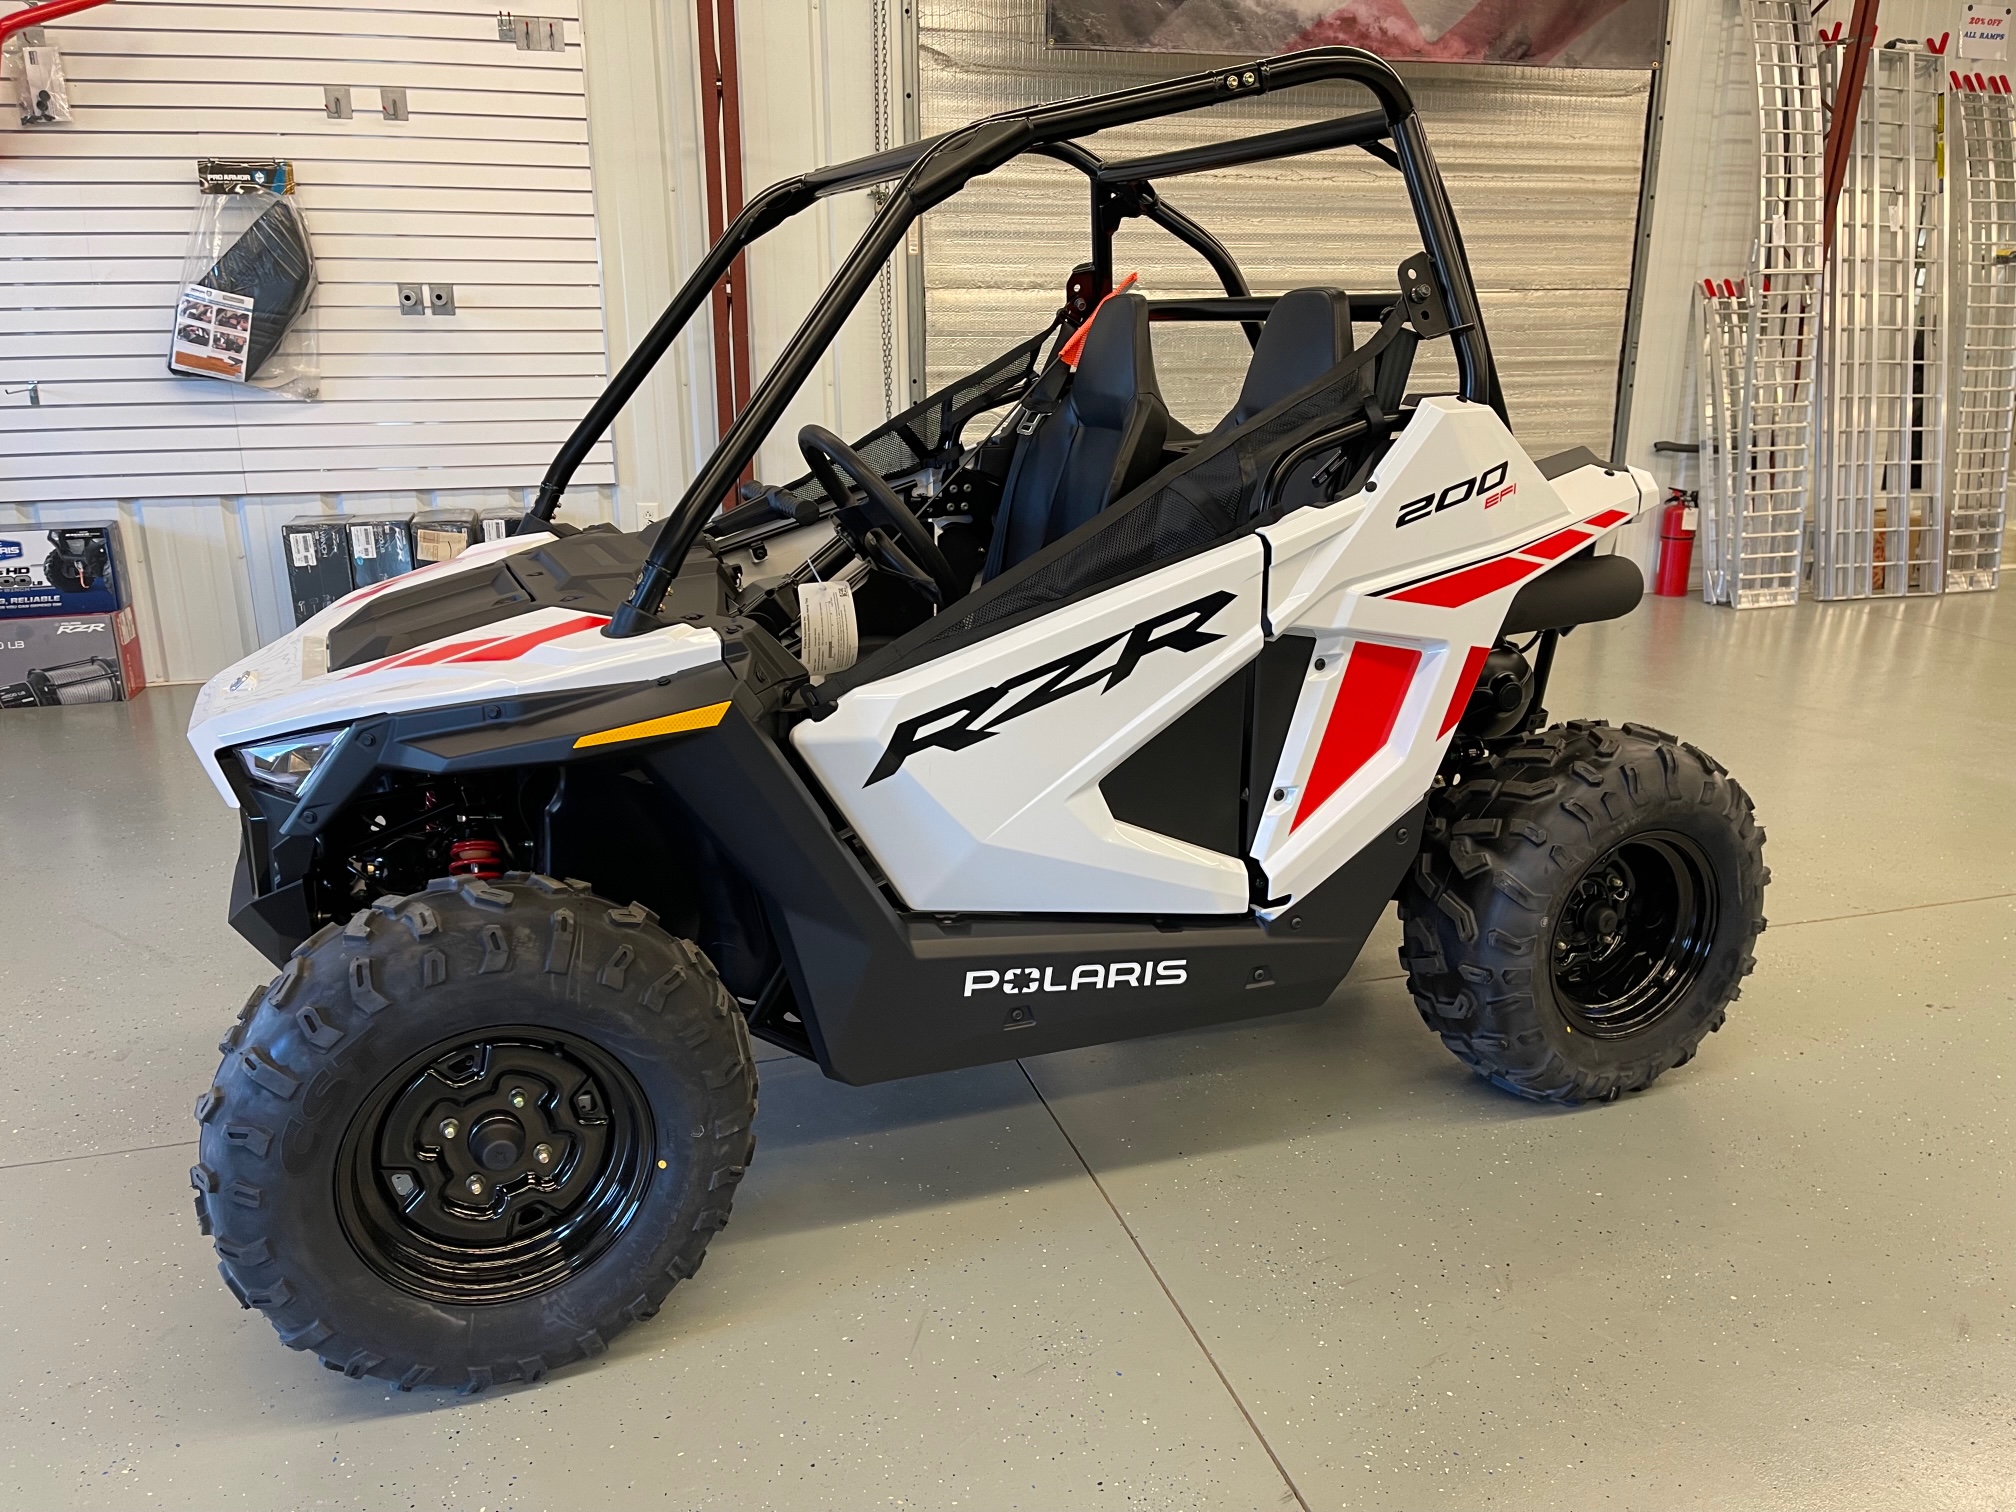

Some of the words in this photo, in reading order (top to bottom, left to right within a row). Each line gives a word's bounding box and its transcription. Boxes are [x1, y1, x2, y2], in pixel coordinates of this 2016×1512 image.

[1968, 17, 1986, 26] 20%
[1987, 19, 2003, 27] OFF
[1964, 31, 1976, 39] ALL
[1979, 32, 2005, 40] RAMPS
[1395, 460, 1509, 528] 200
[1484, 483, 1517, 509] EFI
[0, 546, 20, 554] RIS
[6, 567, 30, 575] HD
[10, 595, 61, 604] RELIABLE
[56, 623, 106, 635] RZR
[8, 640, 25, 649] LB
[862, 590, 1238, 788] RZR
[963, 959, 1188, 997] POLARIS
[280, 1021, 382, 1177] CST
